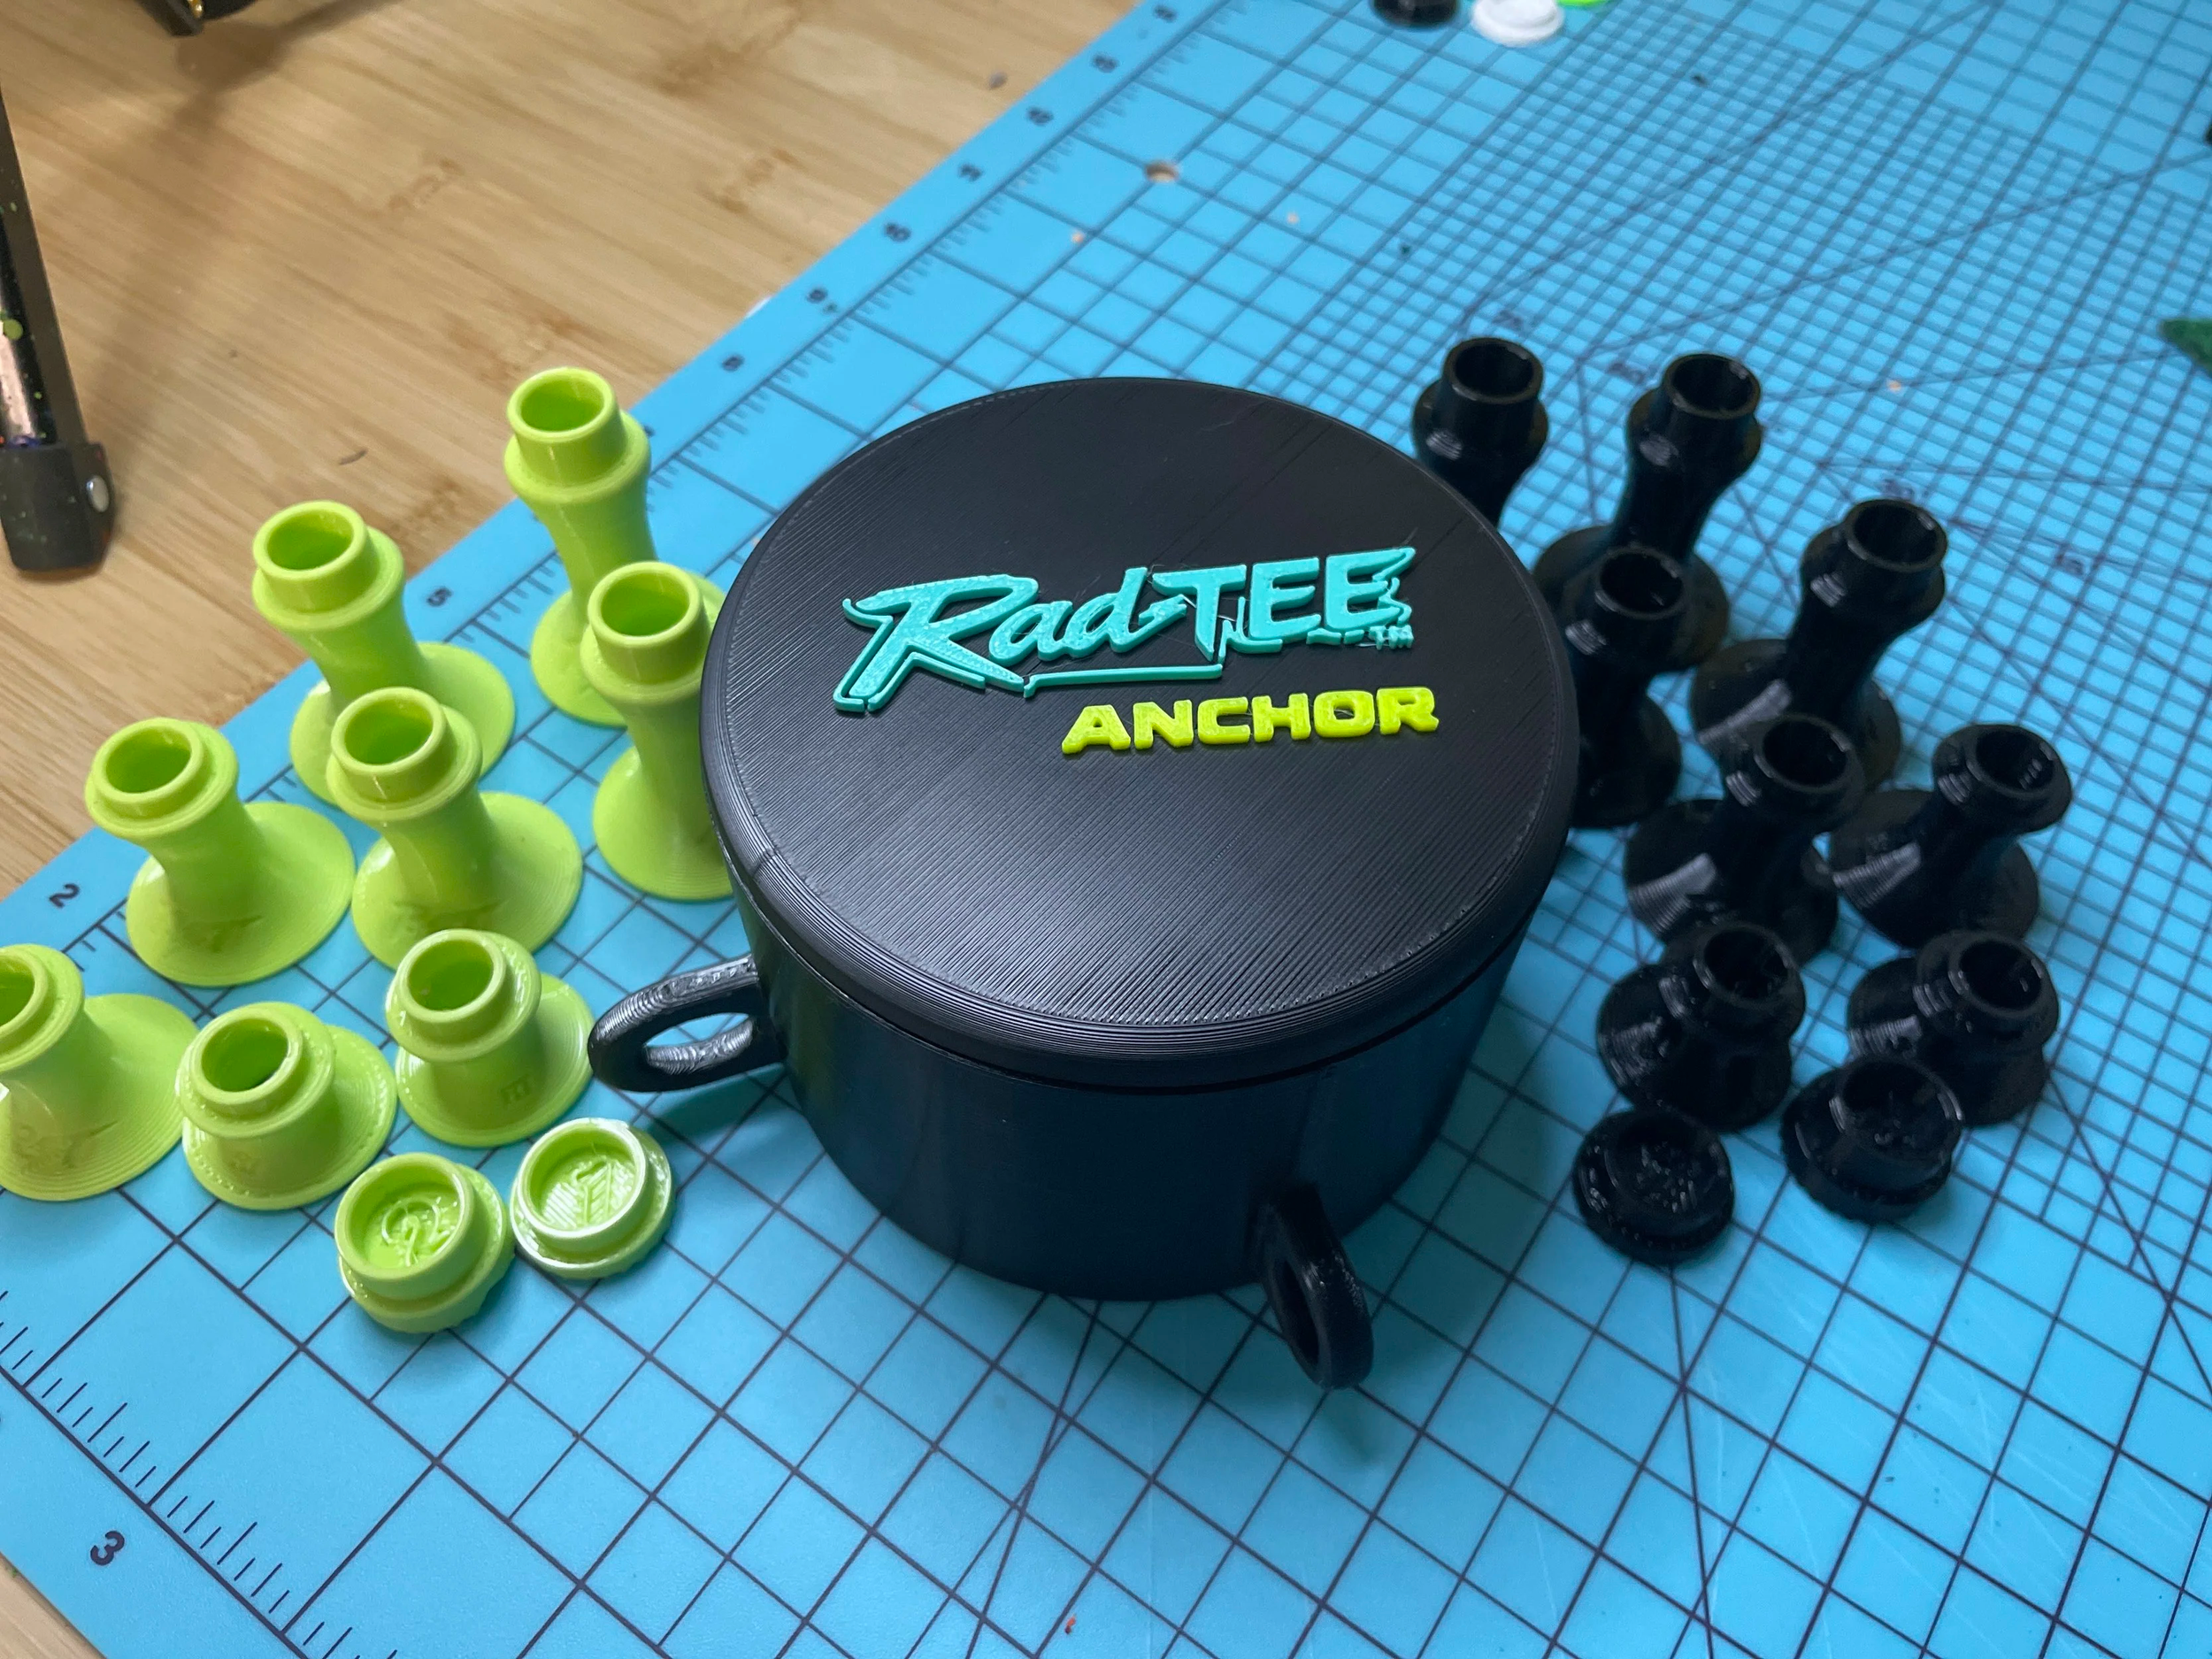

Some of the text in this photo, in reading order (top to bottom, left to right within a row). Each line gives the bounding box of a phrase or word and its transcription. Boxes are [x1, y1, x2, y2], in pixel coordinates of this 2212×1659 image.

[1062, 686, 1439, 754] ANCHOR
[49, 883, 81, 910] 2
[90, 1530, 125, 1566] 3
